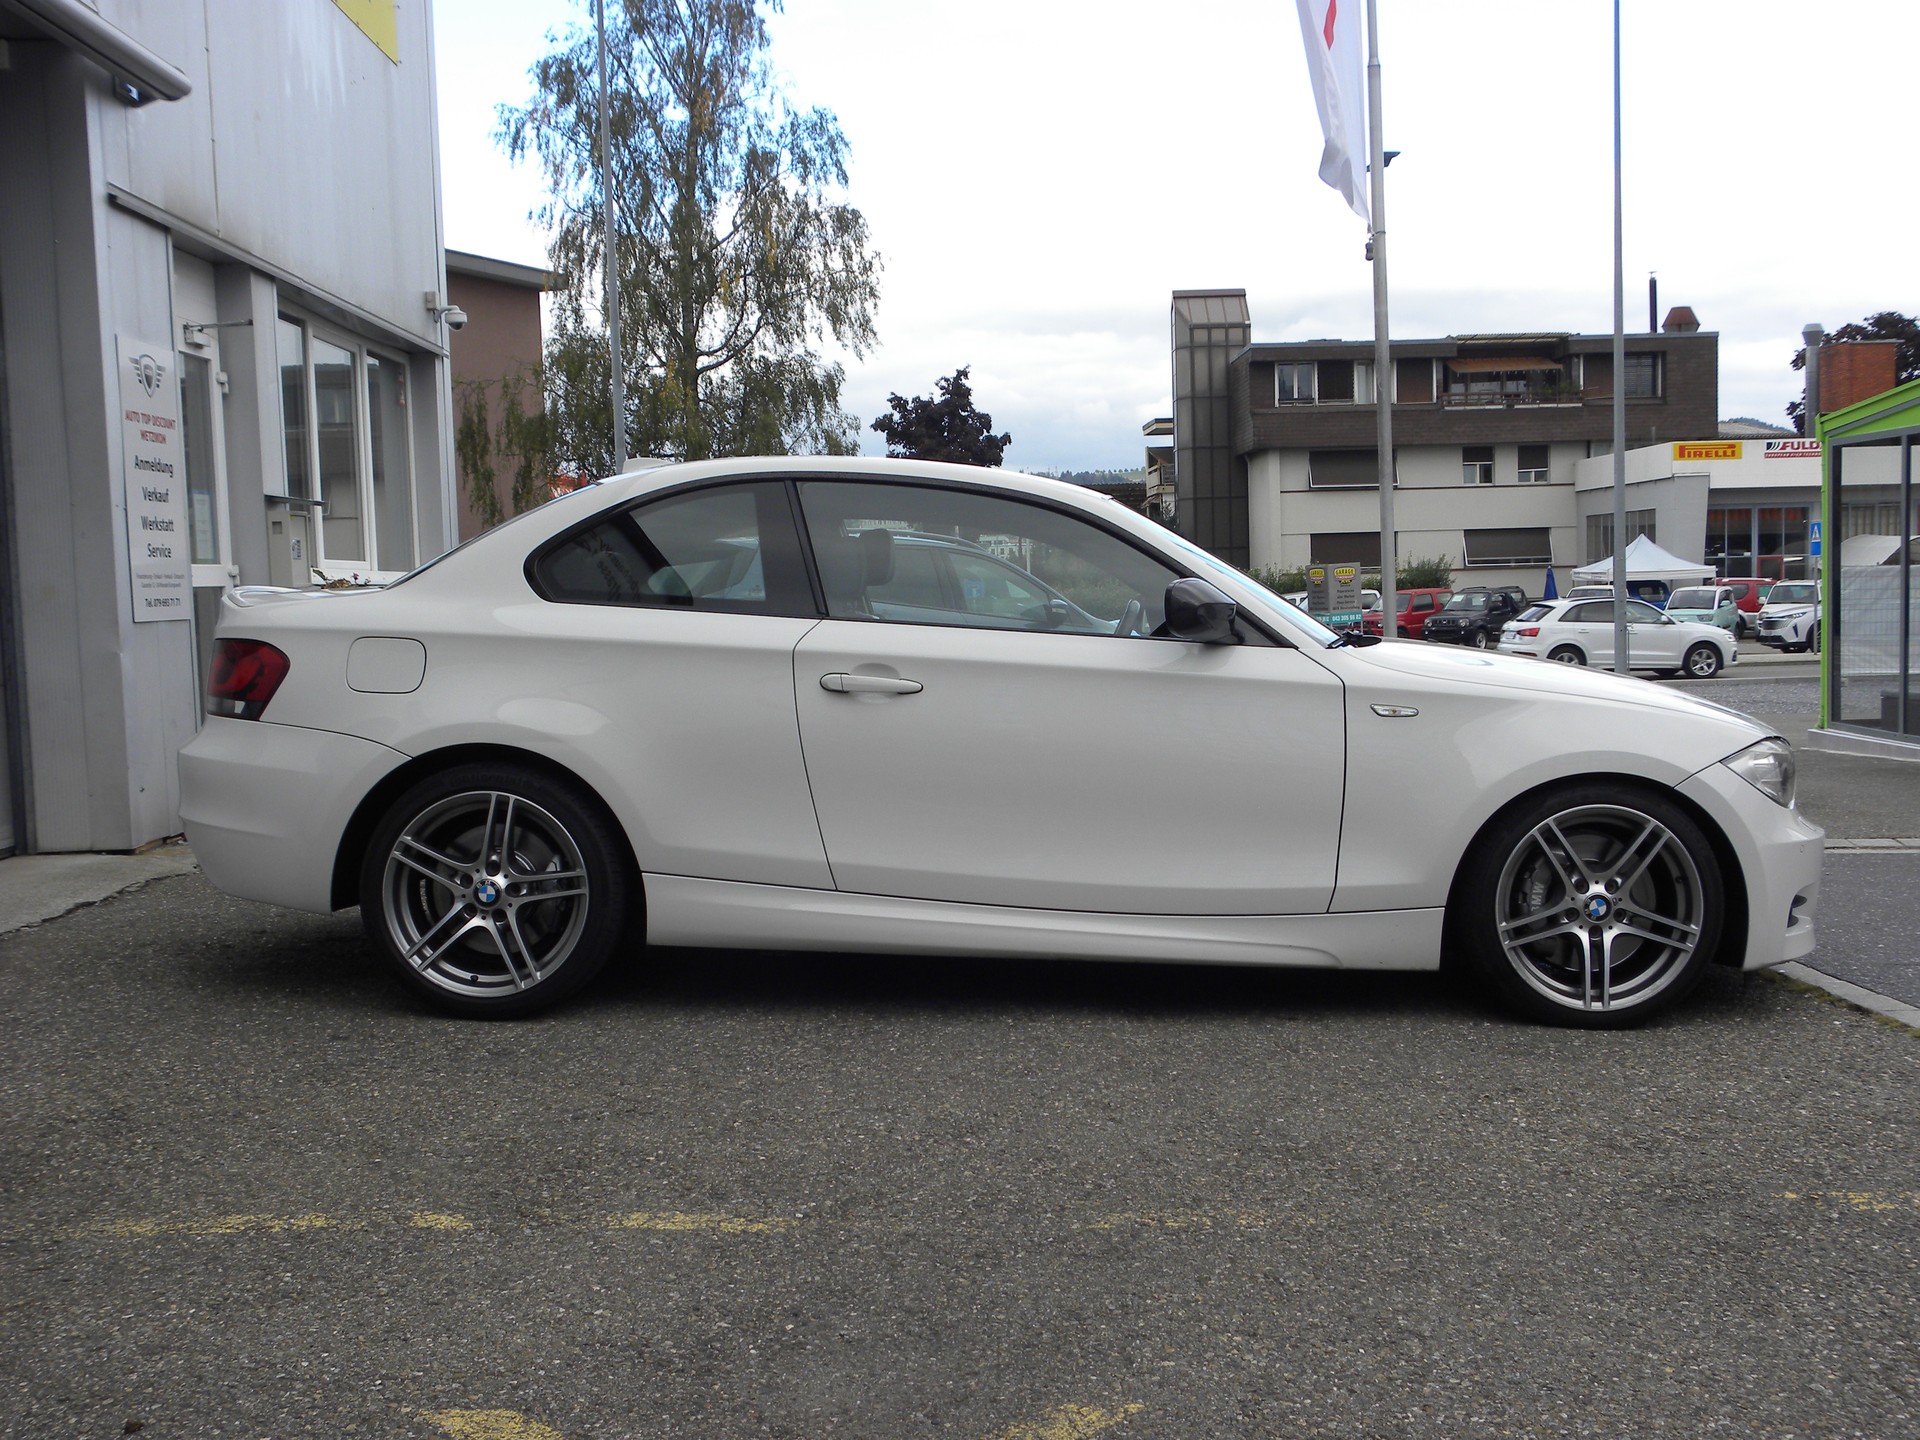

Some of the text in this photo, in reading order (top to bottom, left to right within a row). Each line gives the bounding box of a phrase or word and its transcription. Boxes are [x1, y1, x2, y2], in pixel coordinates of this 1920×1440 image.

[125, 410, 176, 430] AUTO TOP DISCOUNT
[1679, 444, 1736, 458] PIRELLI
[1779, 441, 1822, 451] FULD
[134, 455, 174, 478] Anmeldung
[142, 486, 169, 503] Verkauf
[141, 516, 174, 532] Werkstatt
[147, 543, 172, 558] Service
